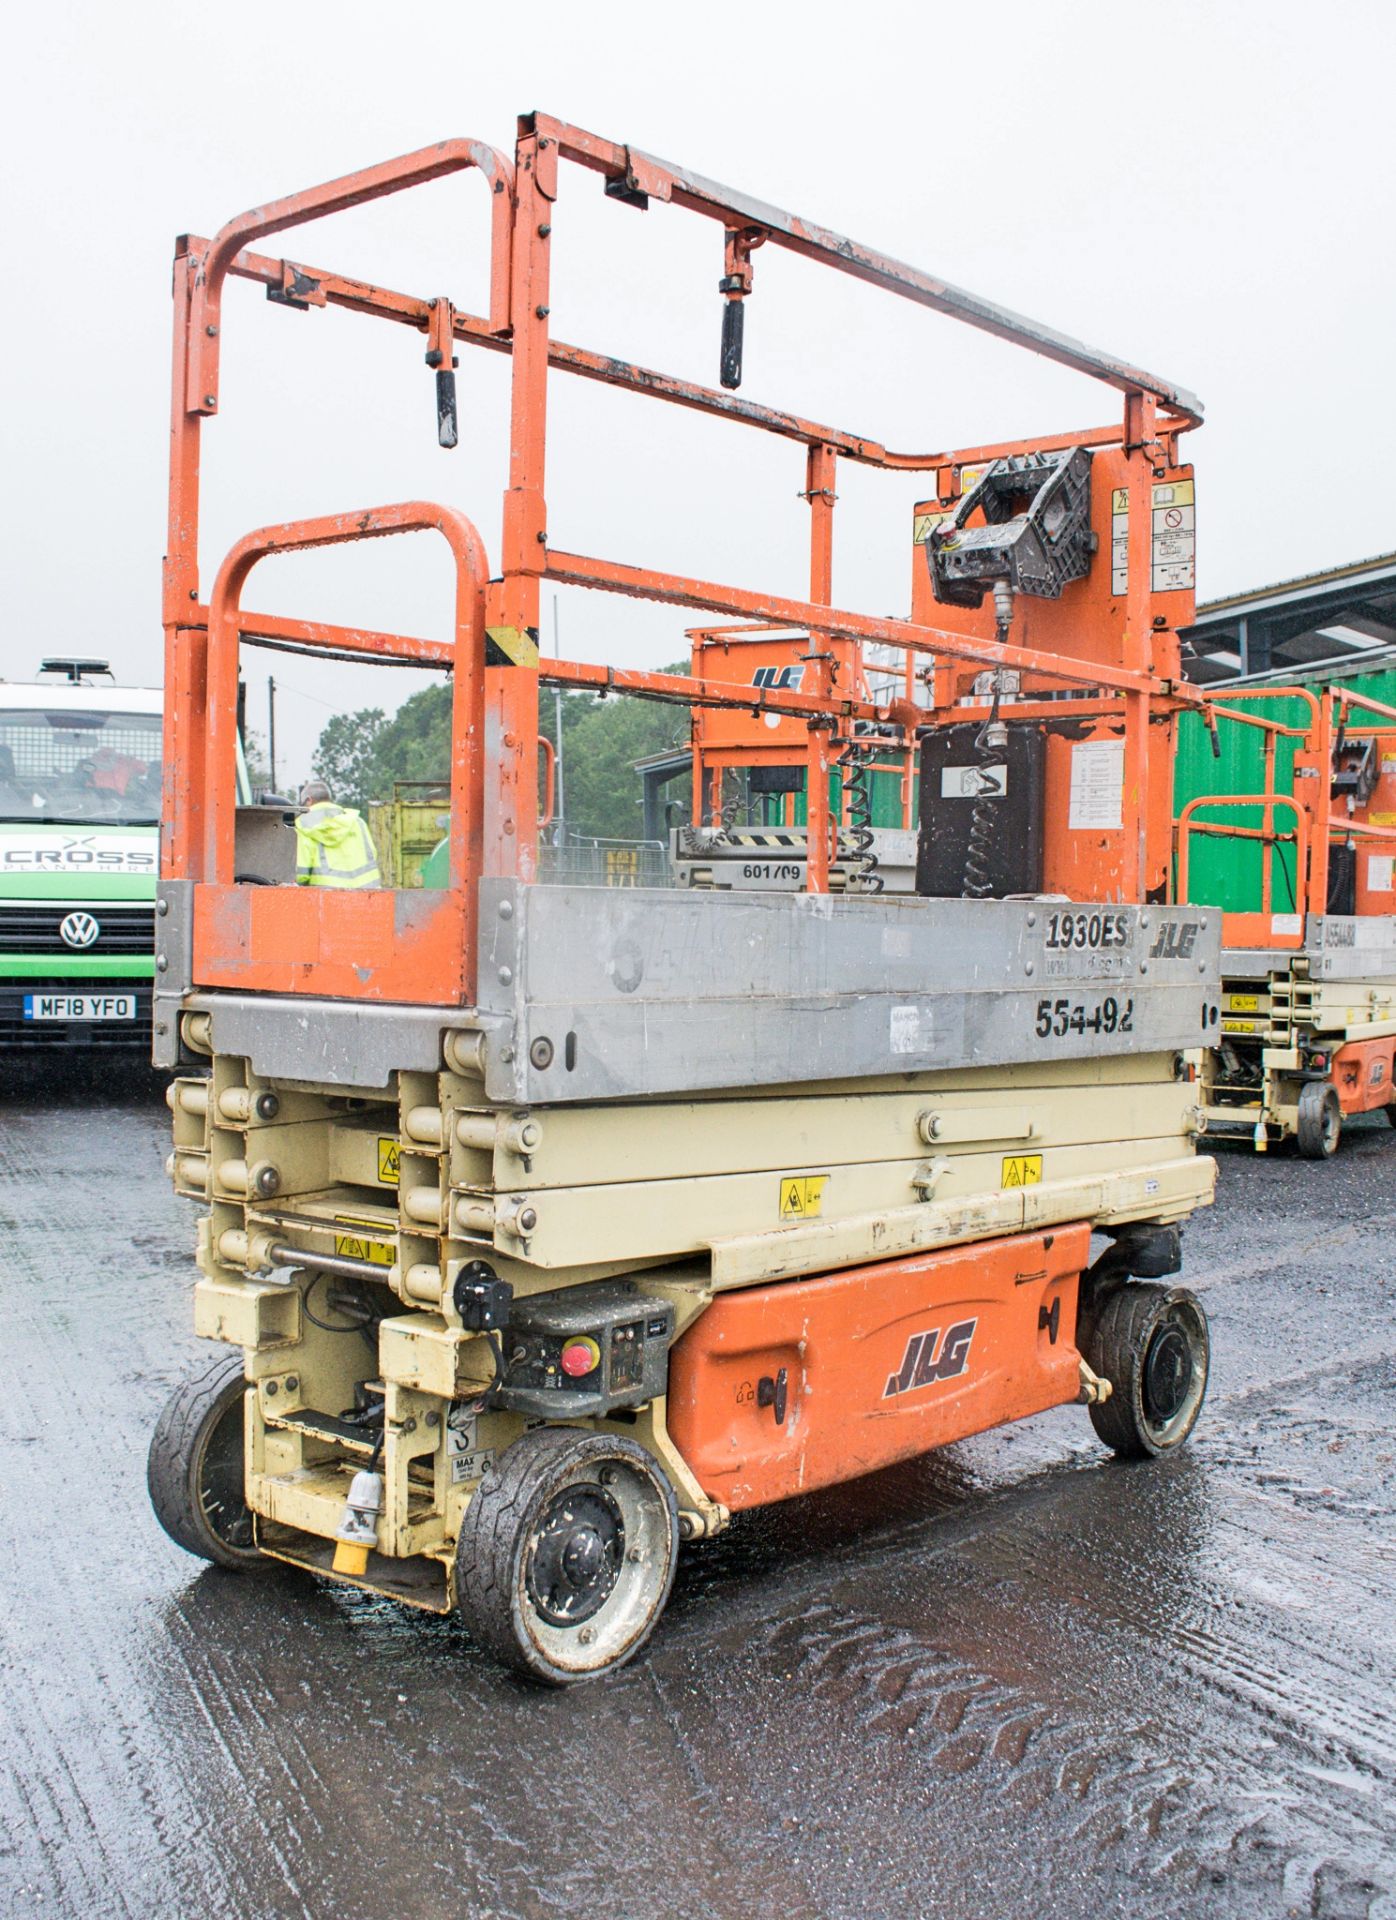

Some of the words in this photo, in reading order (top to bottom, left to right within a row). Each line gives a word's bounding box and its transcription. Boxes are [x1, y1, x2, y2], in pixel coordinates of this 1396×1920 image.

[4, 850, 154, 865] CROSS
[1046, 914, 1128, 948] 1930ES
[1149, 921, 1199, 959] JLG
[40, 998, 85, 1016] MF18
[90, 998, 128, 1016] YFO
[1035, 997, 1133, 1038] 554492
[881, 1316, 979, 1400] JLG
[456, 1456, 474, 1468] MAX
